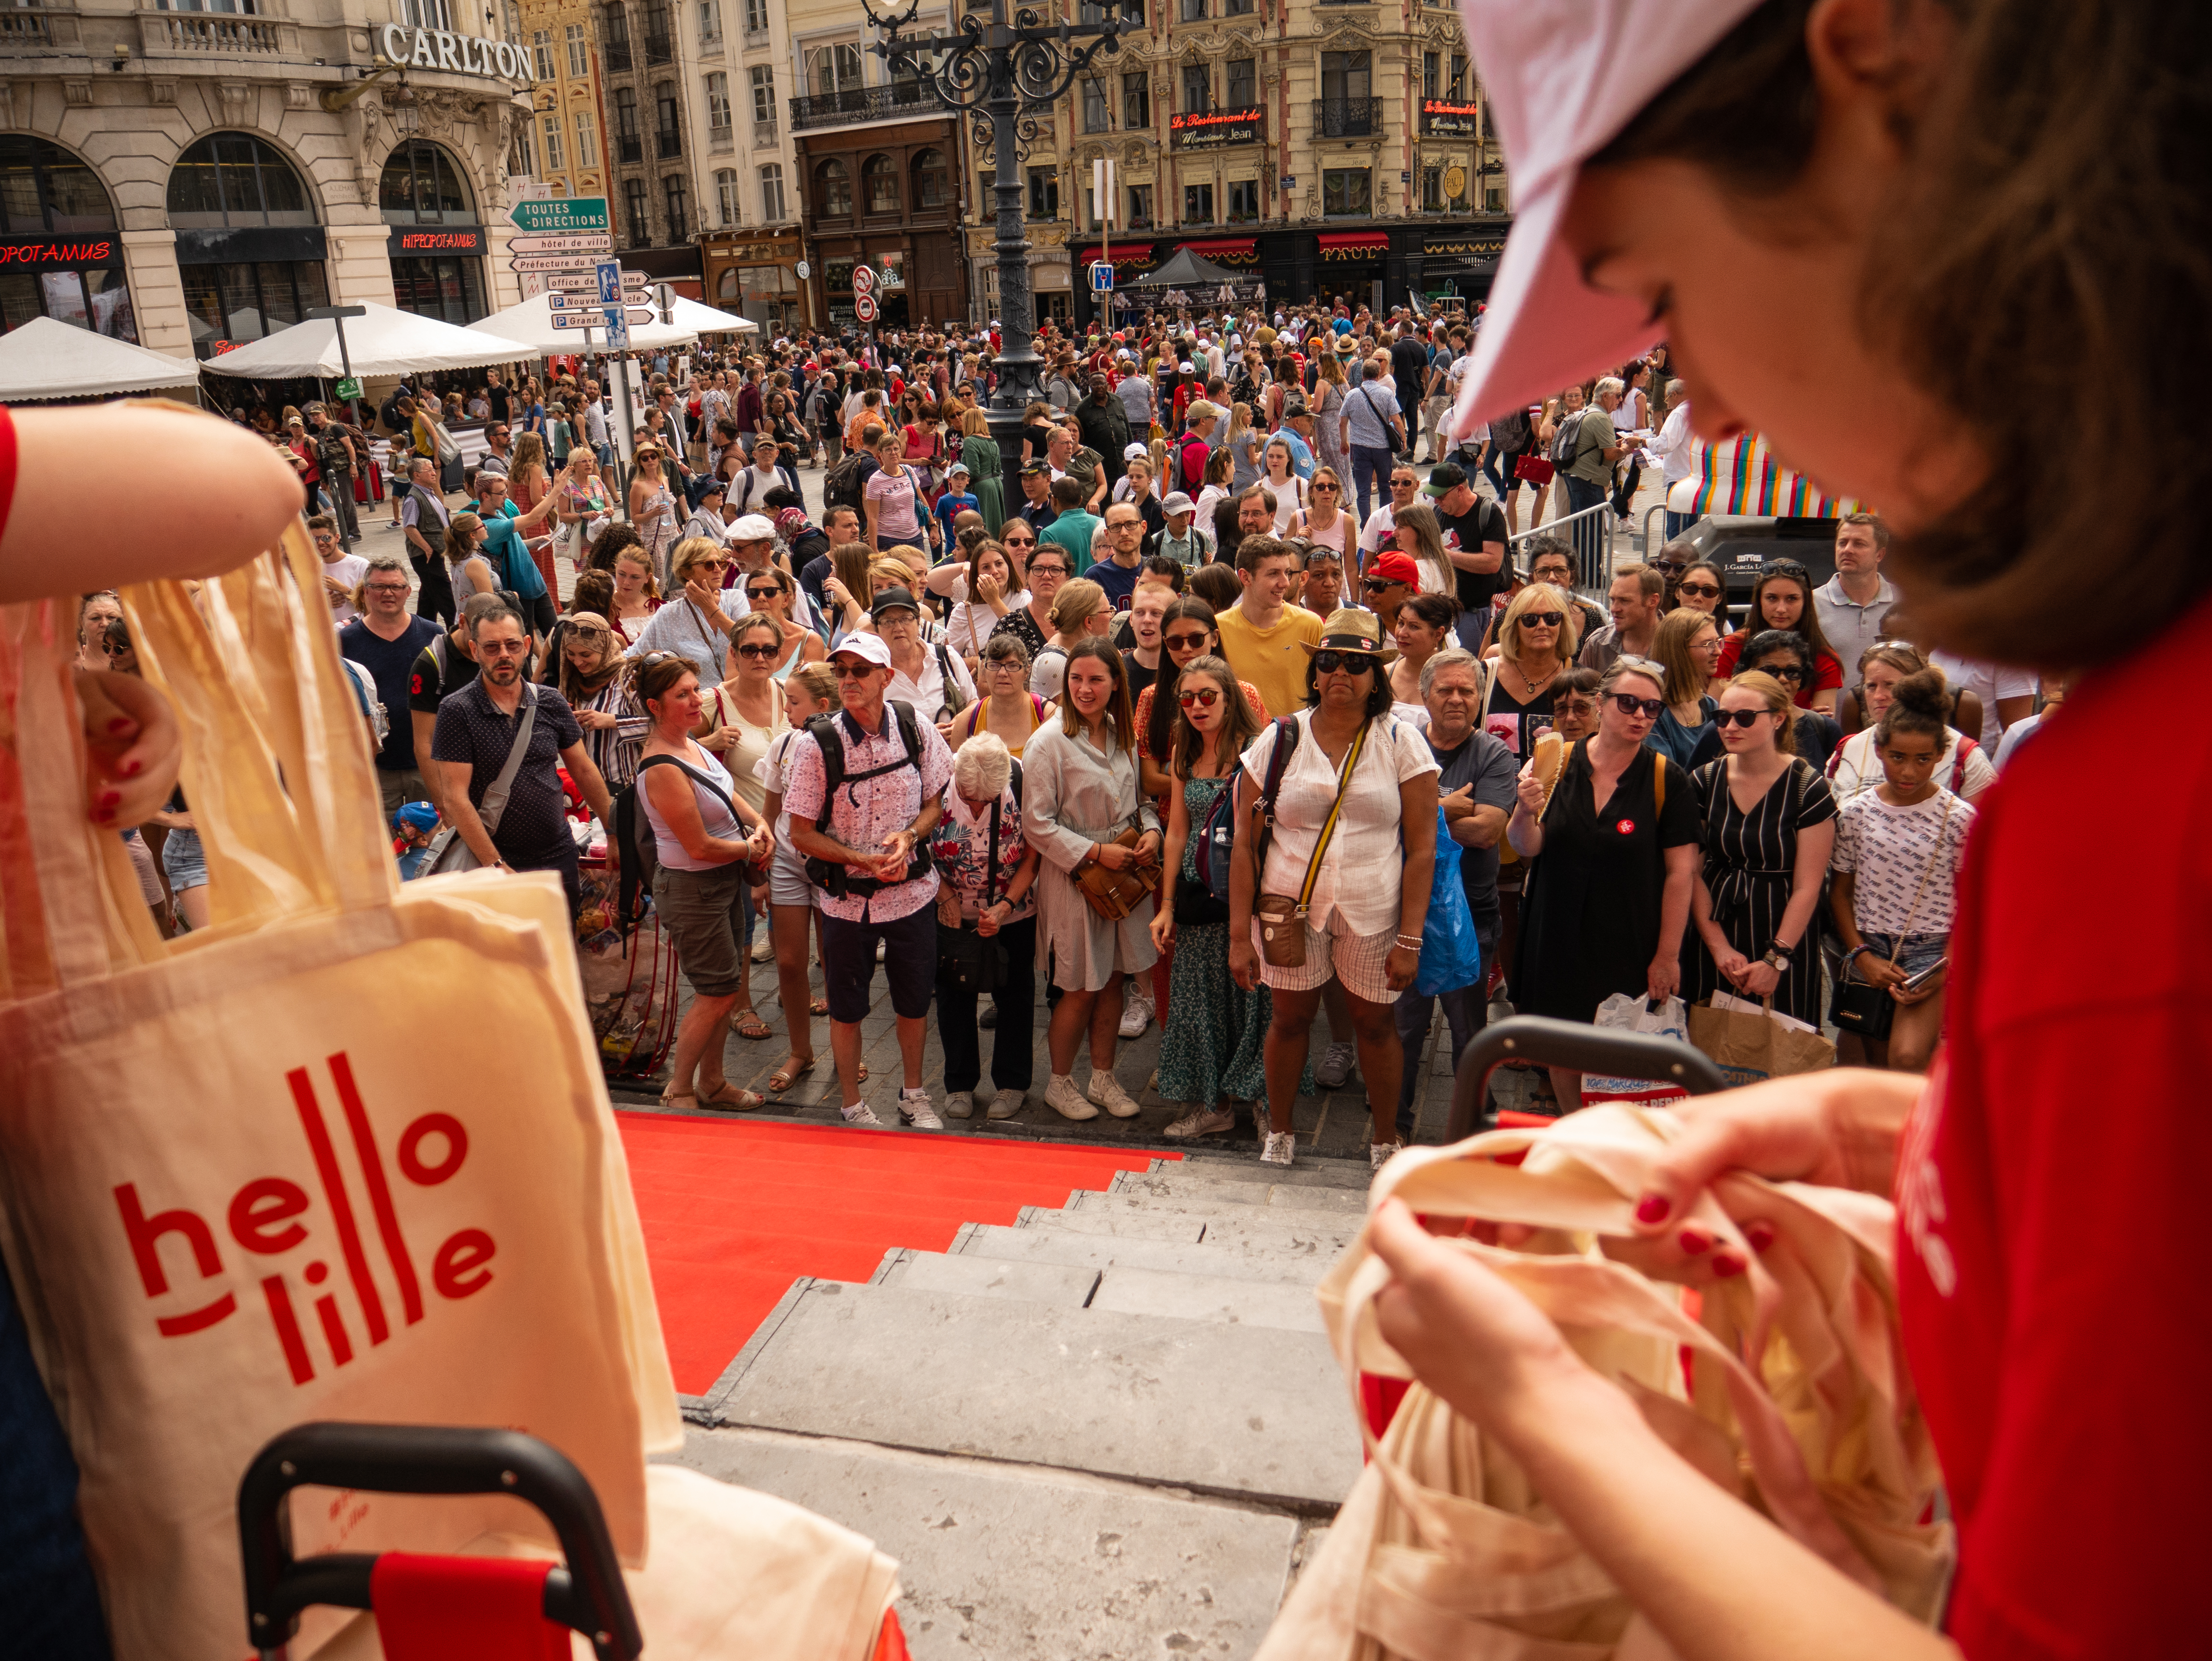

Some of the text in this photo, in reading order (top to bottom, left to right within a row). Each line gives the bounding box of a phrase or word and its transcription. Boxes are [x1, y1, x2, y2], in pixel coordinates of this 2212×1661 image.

[380, 23, 534, 81] CARLTON
[1186, 110, 1246, 127] Restaurant
[1247, 109, 1261, 120] de
[1182, 128, 1251, 144] Monsieur Jean
[1446, 176, 1463, 187] PAUL
[525, 203, 569, 215] TOUTES
[403, 233, 476, 248] HIPPOPOTAMUS
[541, 238, 608, 248] hôtel de ville
[1325, 249, 1376, 261] PAUL
[520, 260, 569, 269] Préfecture
[552, 278, 579, 287] office
[584, 277, 594, 285] de
[567, 297, 600, 305] Nouvea
[570, 315, 597, 324] Grand
[412, 674, 422, 695] 3
[1870, 807, 1897, 824] GRL PWR
[1911, 811, 1922, 819] GRL
[1919, 833, 1932, 843] GRL
[1874, 853, 1889, 864] PWR
[1900, 846, 1926, 862] GRL PWR
[1875, 894, 1889, 904] PWR
[113, 1051, 469, 1299] hello
